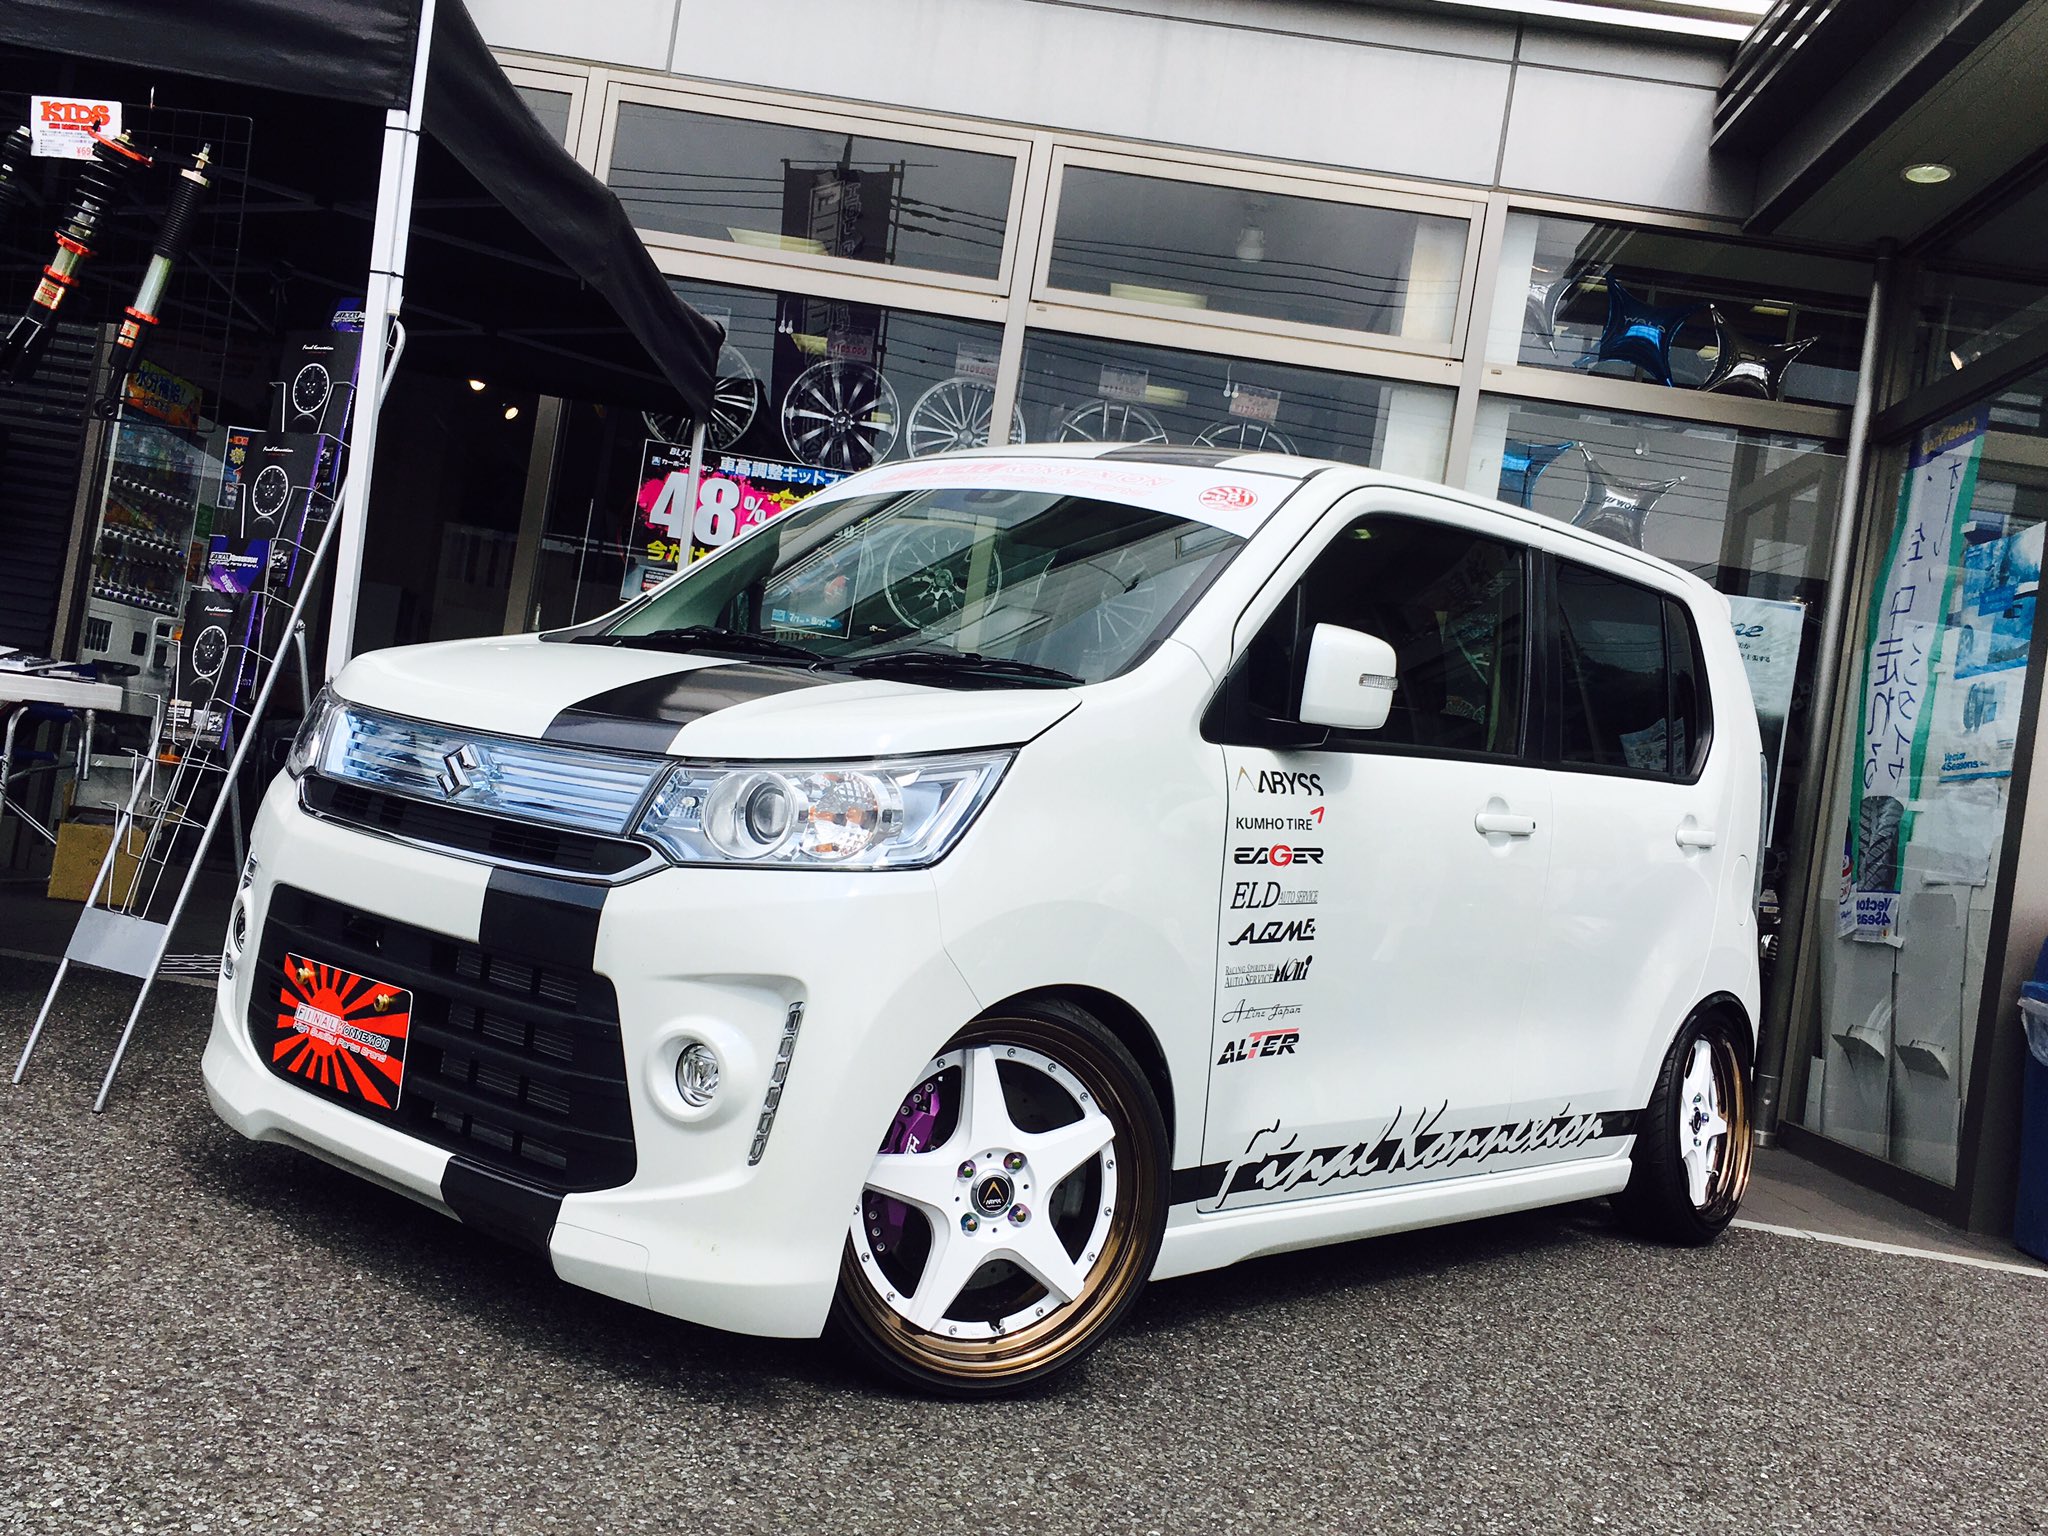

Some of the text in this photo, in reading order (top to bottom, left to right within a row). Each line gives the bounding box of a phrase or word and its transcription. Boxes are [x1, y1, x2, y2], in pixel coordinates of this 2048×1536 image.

[40, 101, 110, 126] KIDS
[669, 447, 692, 459] BLIT
[719, 456, 846, 487] 車高調整キットフ
[1258, 770, 1324, 796] ABYSS
[1236, 817, 1313, 830] KUMHO TIRE
[1234, 843, 1324, 867] EAGER
[1230, 881, 1281, 909] ELD
[296, 1003, 340, 1033] FINAL
[1268, 1003, 1303, 1021] Japan
[1217, 1028, 1299, 1066] ALTER
[1214, 1104, 1390, 1209] Final
